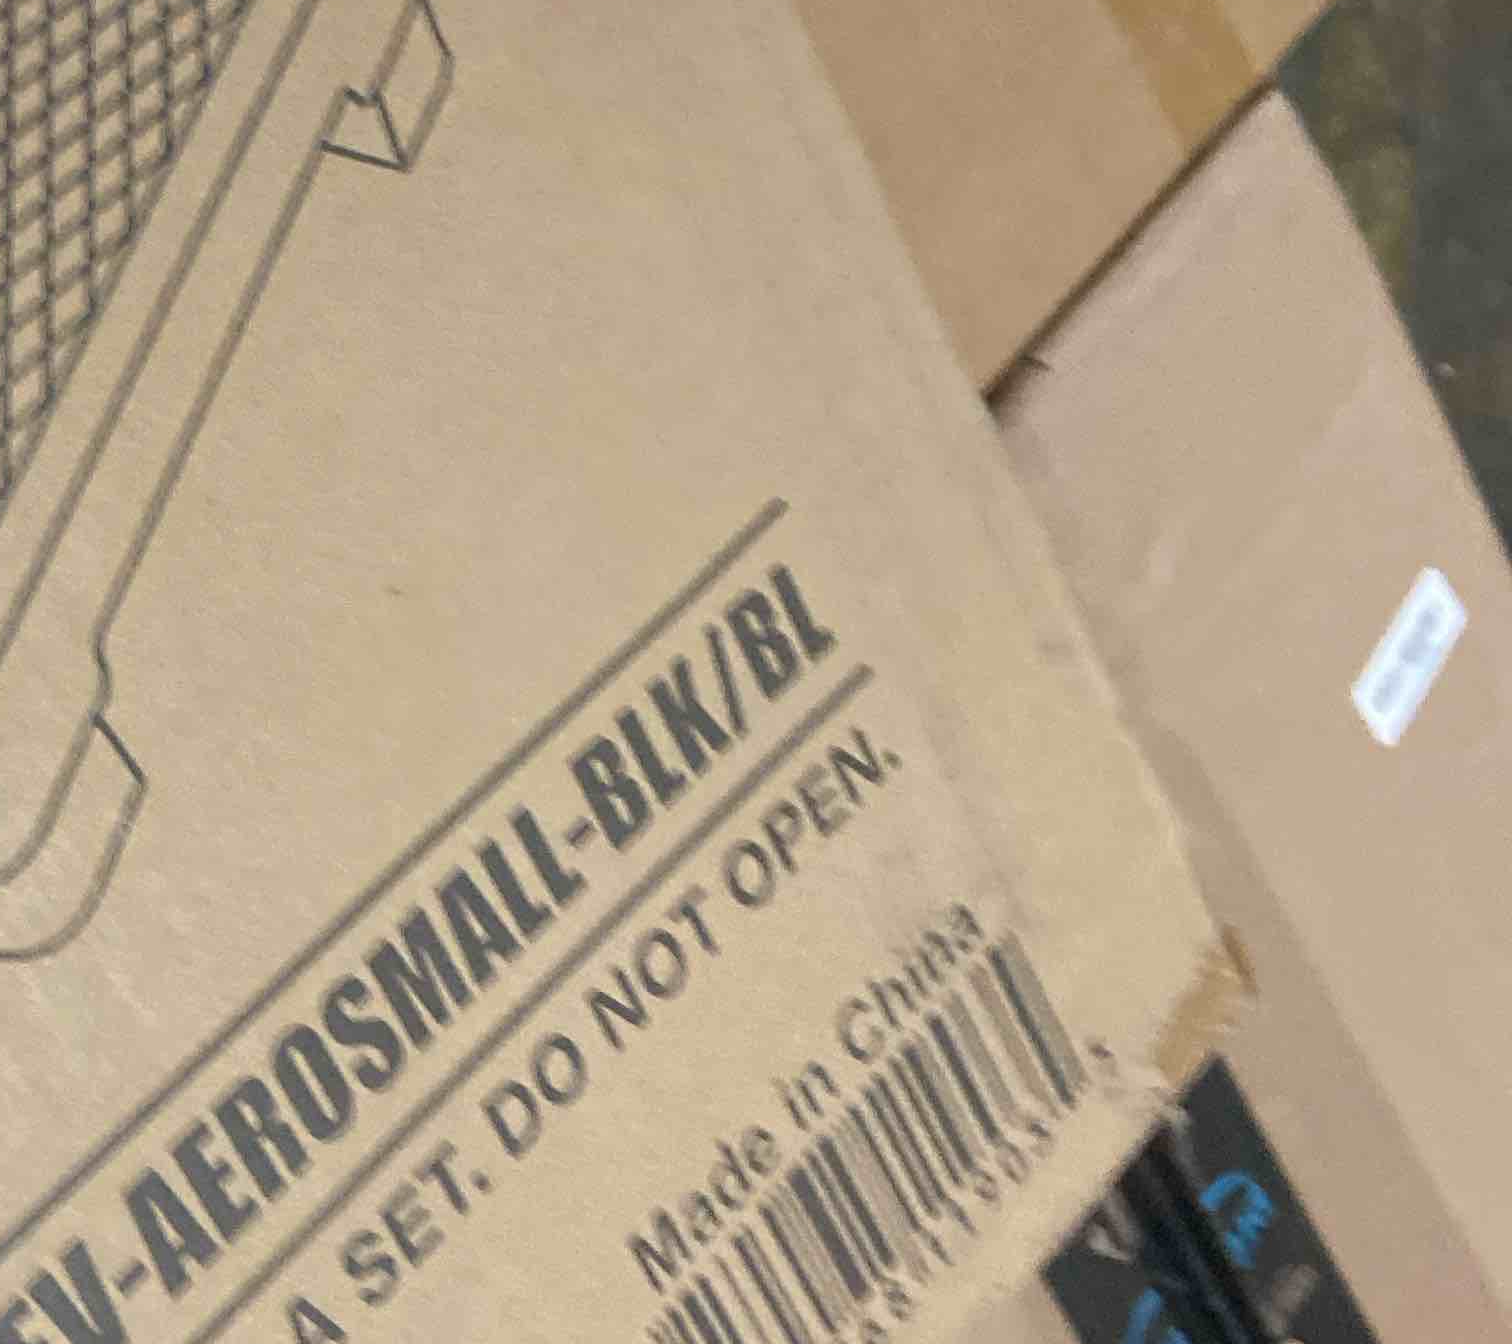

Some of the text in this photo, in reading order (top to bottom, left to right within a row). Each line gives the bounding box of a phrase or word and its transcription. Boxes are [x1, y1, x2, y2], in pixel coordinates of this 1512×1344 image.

[341, 1141, 493, 1306] SET.
[481, 1033, 588, 1160] DO
[583, 885, 722, 1054] NOT
[722, 726, 902, 909] OPEN.
[625, 902, 986, 1296] Made in China
